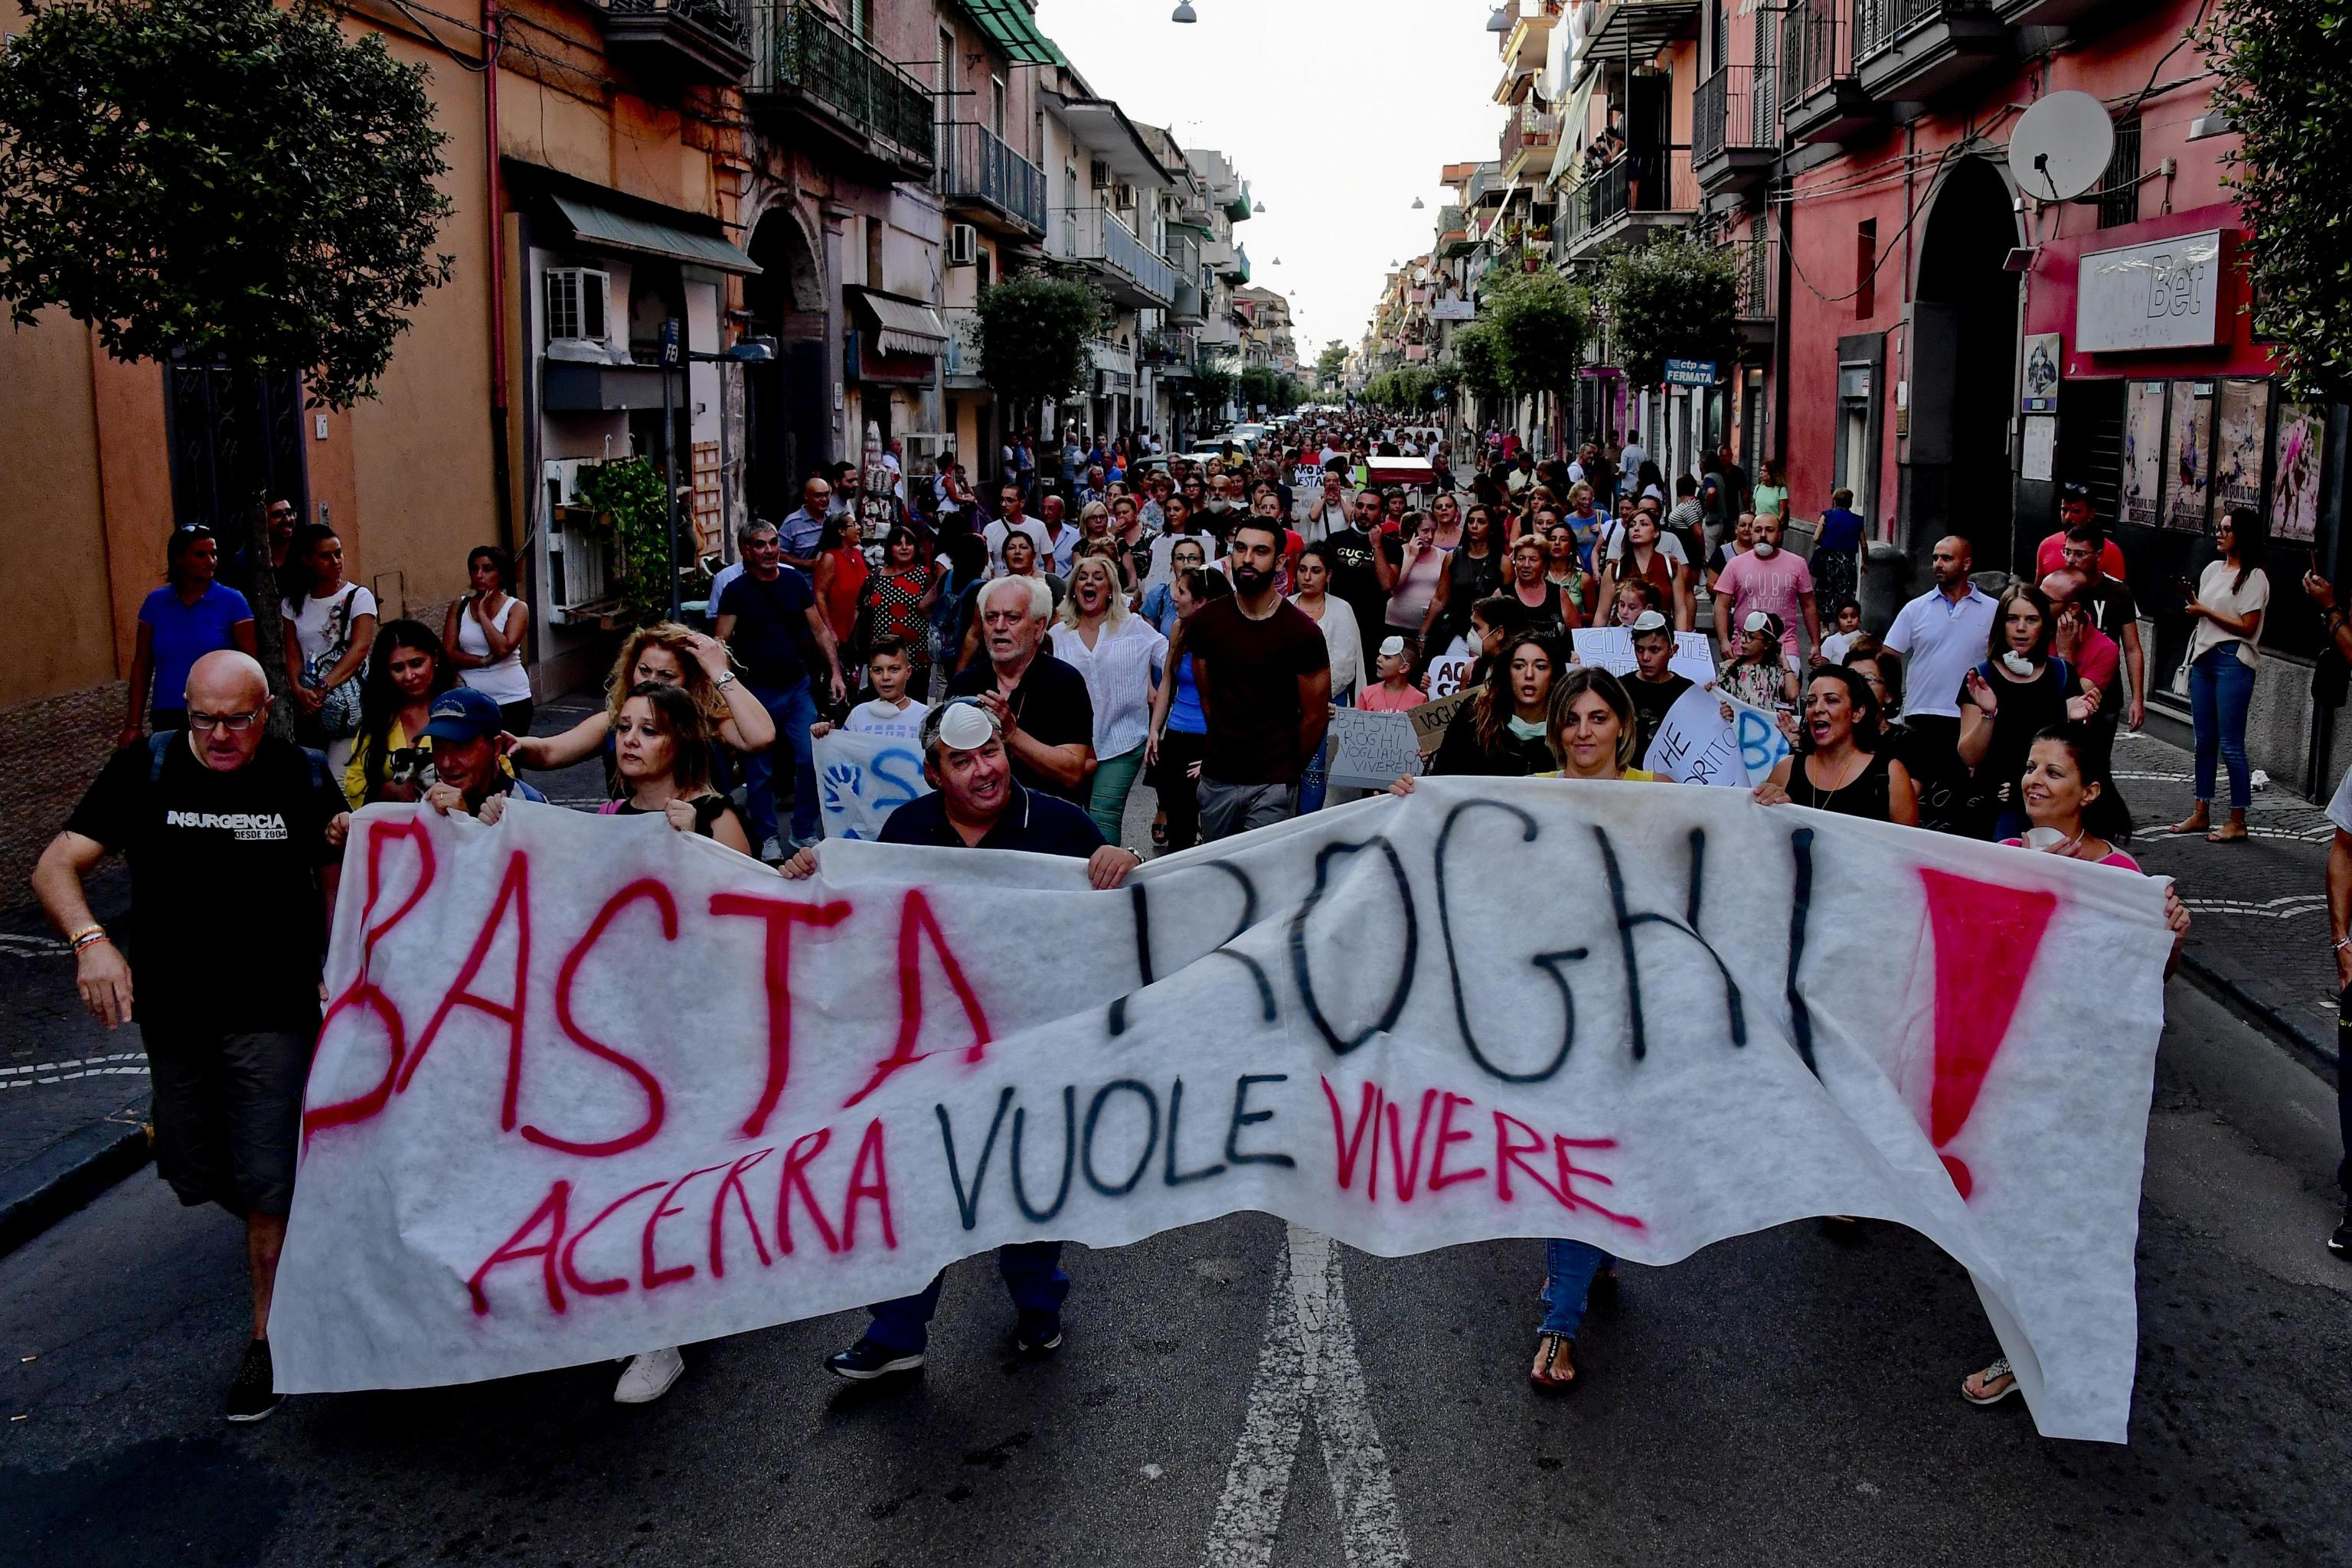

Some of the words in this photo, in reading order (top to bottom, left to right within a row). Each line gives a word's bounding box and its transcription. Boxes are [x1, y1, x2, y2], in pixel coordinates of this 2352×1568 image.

[2148, 255, 2203, 318] Bet
[1681, 360, 1697, 371] ctp
[1667, 371, 1712, 384] FERMATA
[1746, 572, 1792, 596] CUBA
[1336, 711, 1408, 737] BASTA
[1343, 730, 1400, 750] ROGHI
[1340, 744, 1416, 763] VOGLIAMO
[167, 810, 286, 829] INSURGENCIA
[235, 831, 262, 839] DESDE
[264, 830, 286, 839] 2004
[303, 816, 992, 1158] BASTA
[467, 1116, 897, 1315] ACERRA
[936, 1073, 1296, 1230] VUOLE
[1320, 1072, 1646, 1229] VIVERE
